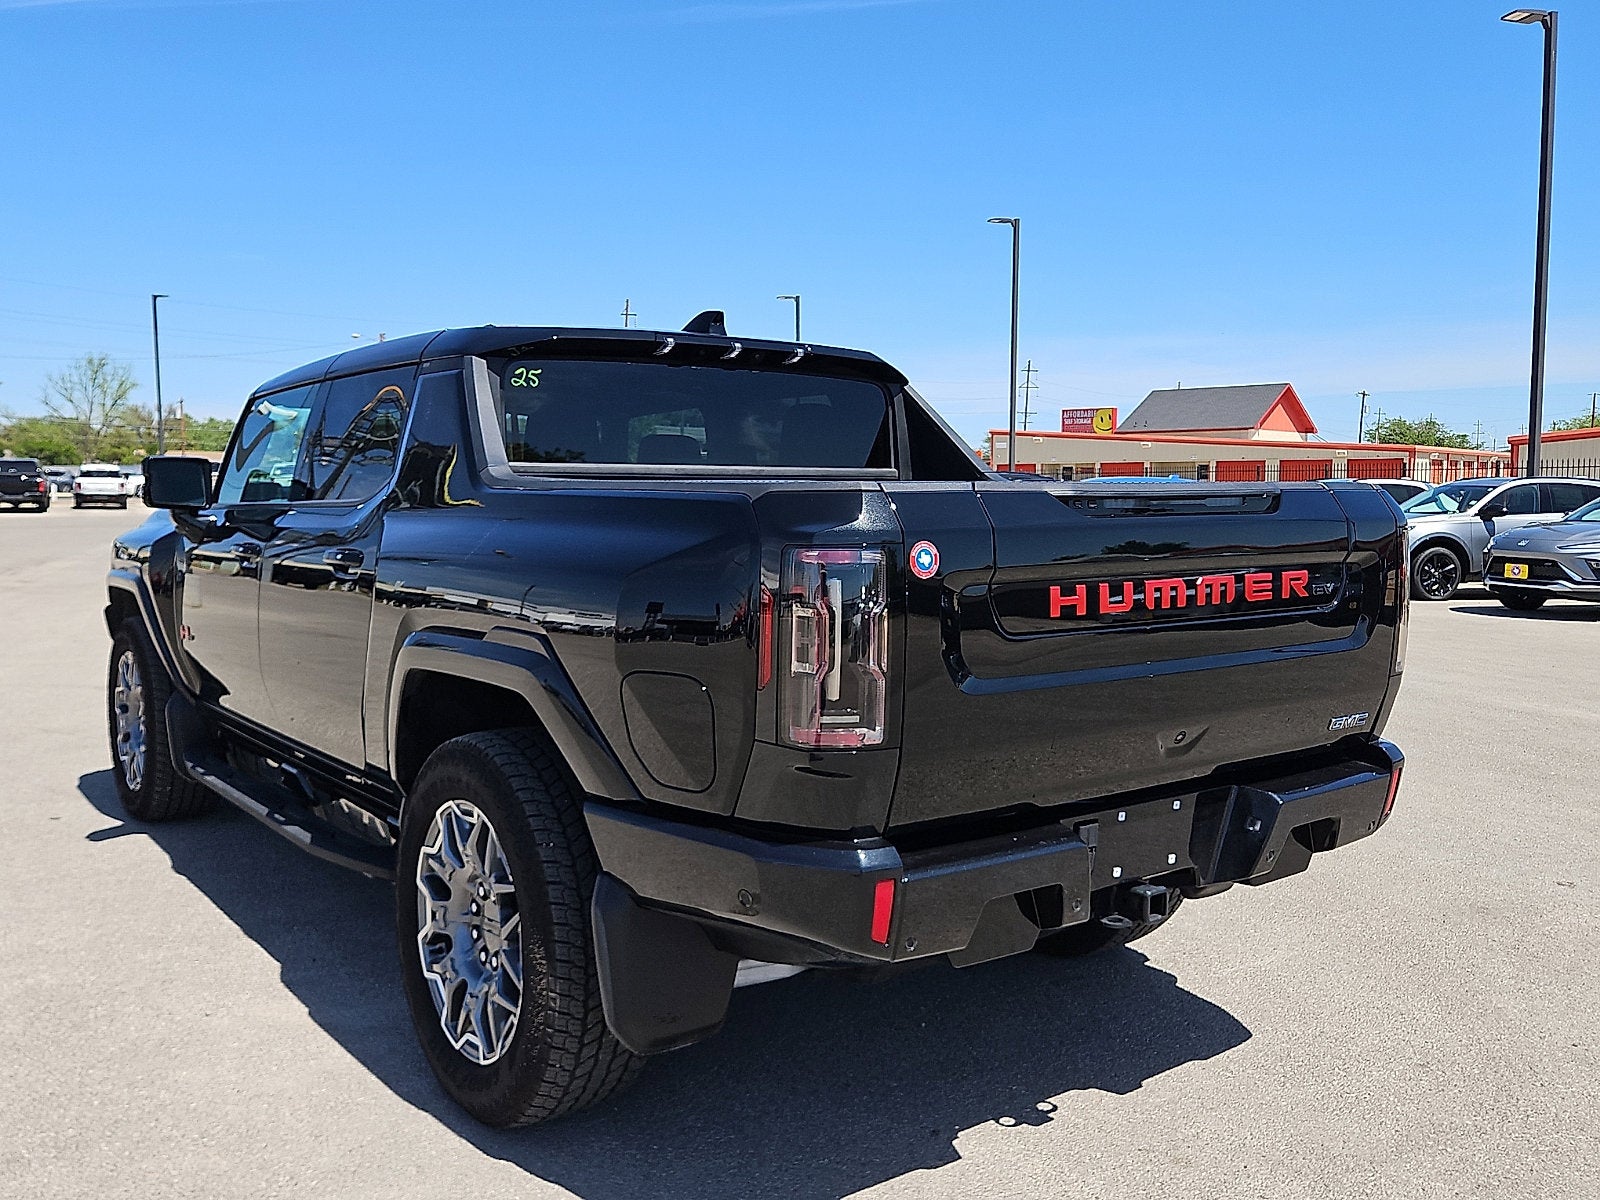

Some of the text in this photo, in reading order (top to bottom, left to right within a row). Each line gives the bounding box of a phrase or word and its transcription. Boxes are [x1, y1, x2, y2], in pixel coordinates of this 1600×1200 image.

[511, 367, 542, 387] 25
[1063, 410, 1097, 418] AFFORDABLE
[1049, 569, 1309, 617] HUMMER
[1329, 712, 1369, 731] GMC
